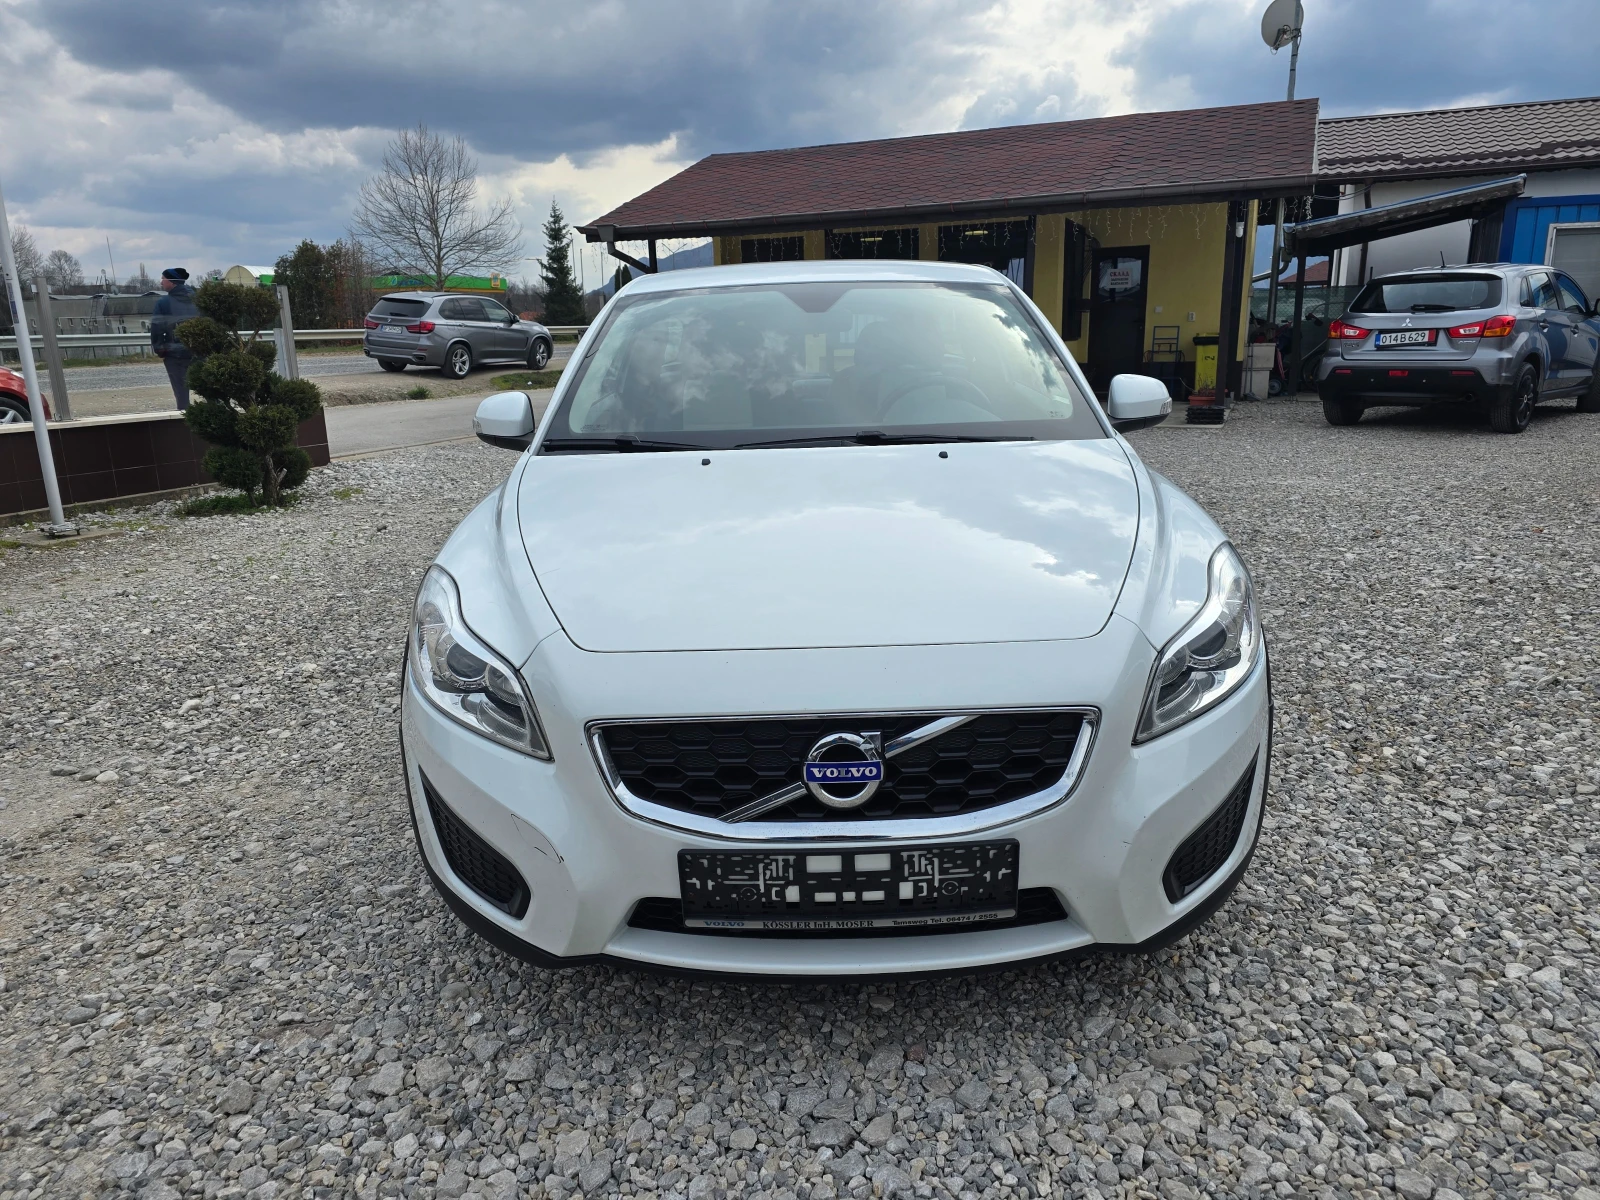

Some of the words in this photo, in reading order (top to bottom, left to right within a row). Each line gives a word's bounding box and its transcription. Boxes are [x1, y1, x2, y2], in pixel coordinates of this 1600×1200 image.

[1381, 332, 1426, 344] 014B629
[810, 767, 877, 778] VOLVO
[762, 920, 811, 929] KÖSSLER
[836, 920, 874, 928] MOSER
